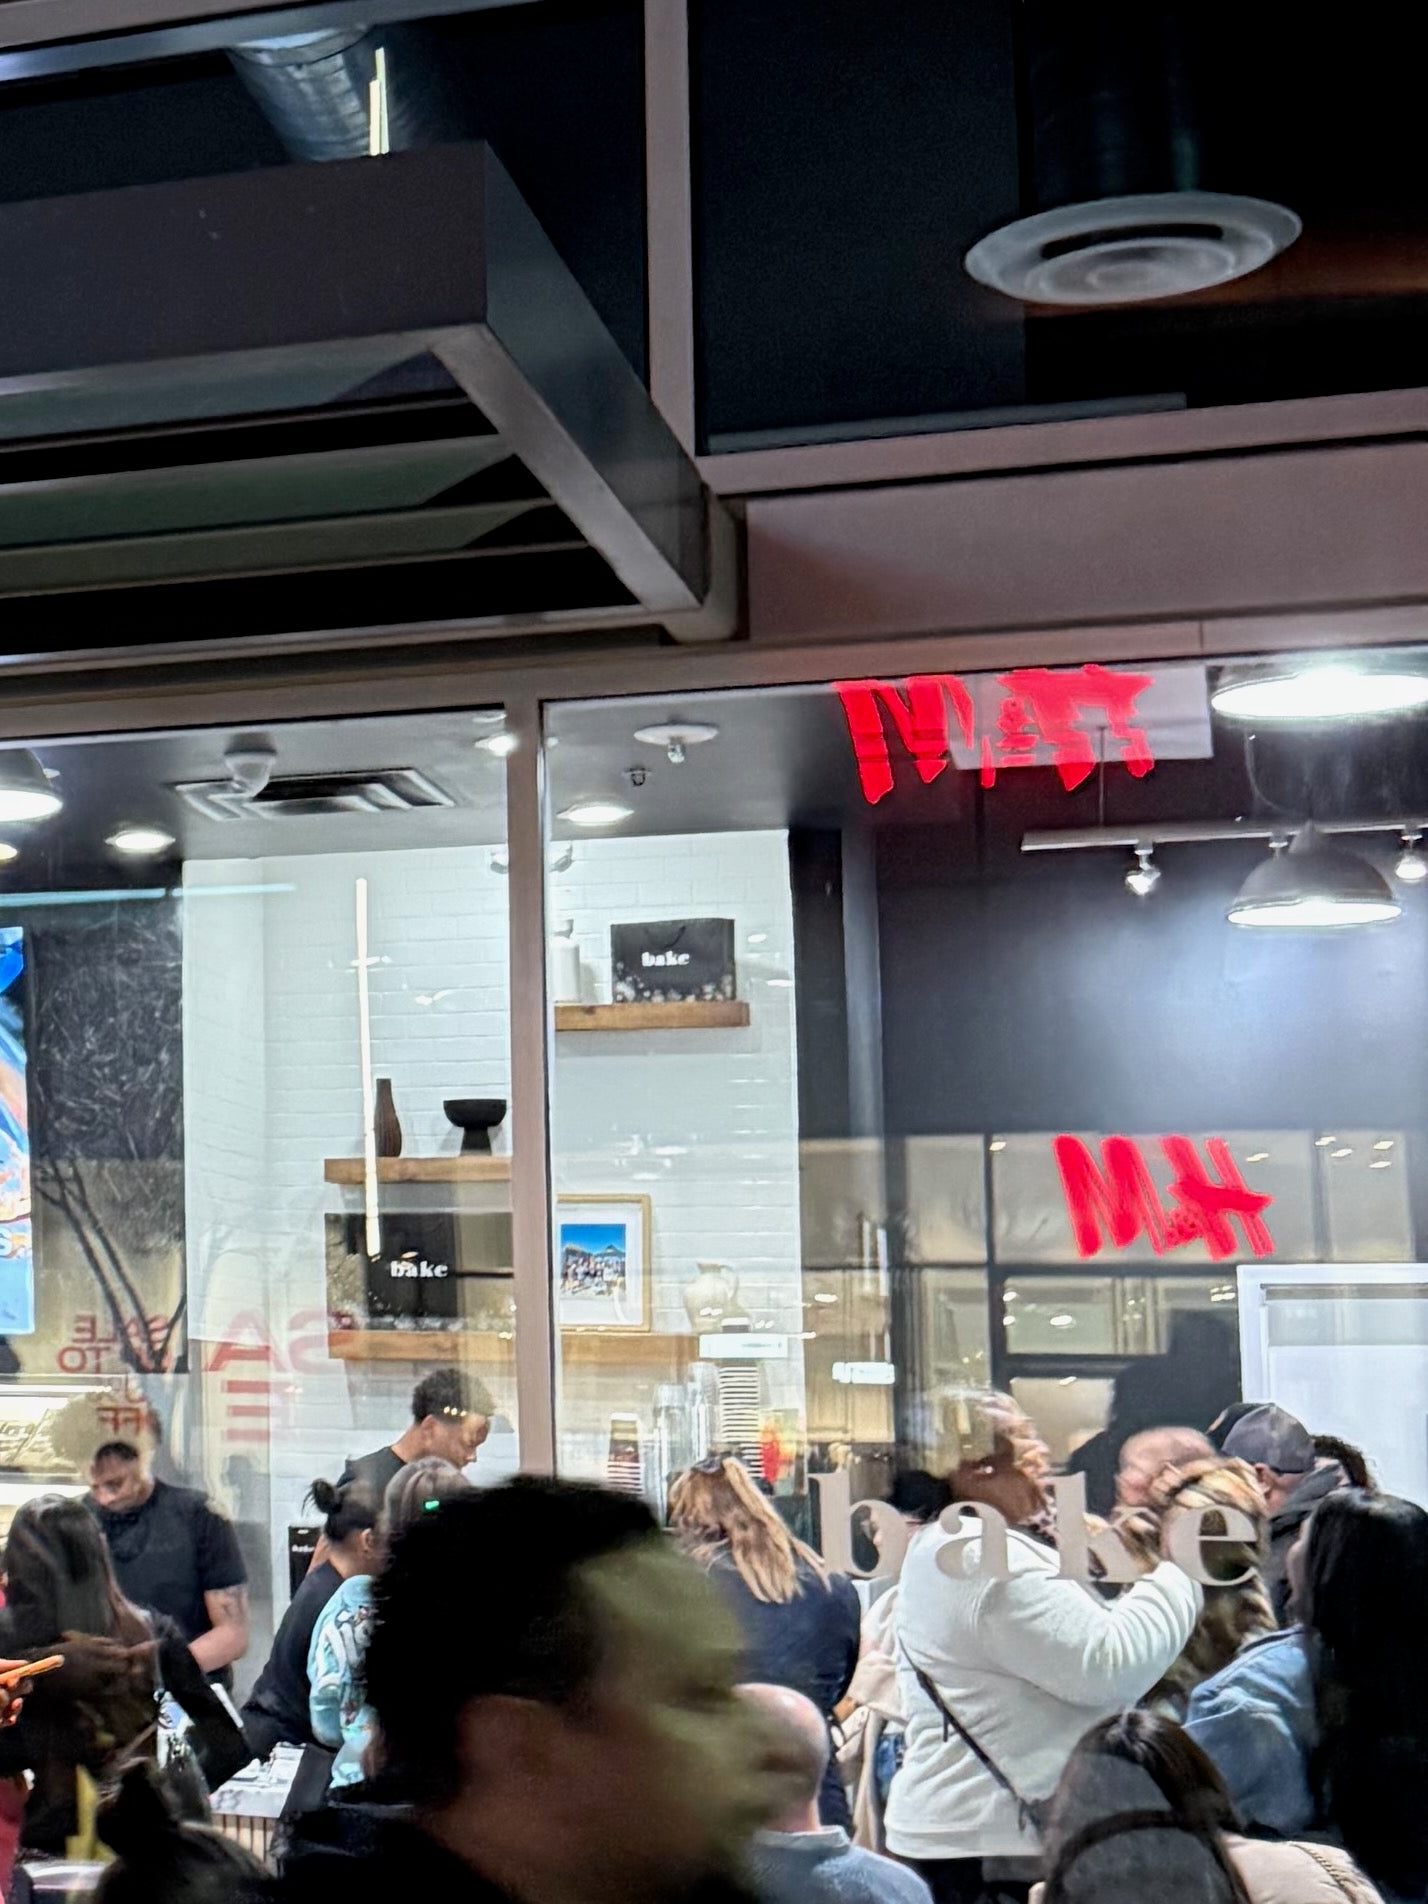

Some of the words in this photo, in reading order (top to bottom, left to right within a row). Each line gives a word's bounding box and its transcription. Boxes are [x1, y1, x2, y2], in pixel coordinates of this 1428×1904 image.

[641, 950, 690, 967] bake
[391, 1260, 448, 1278] bake
[804, 1470, 1259, 1588] bake
